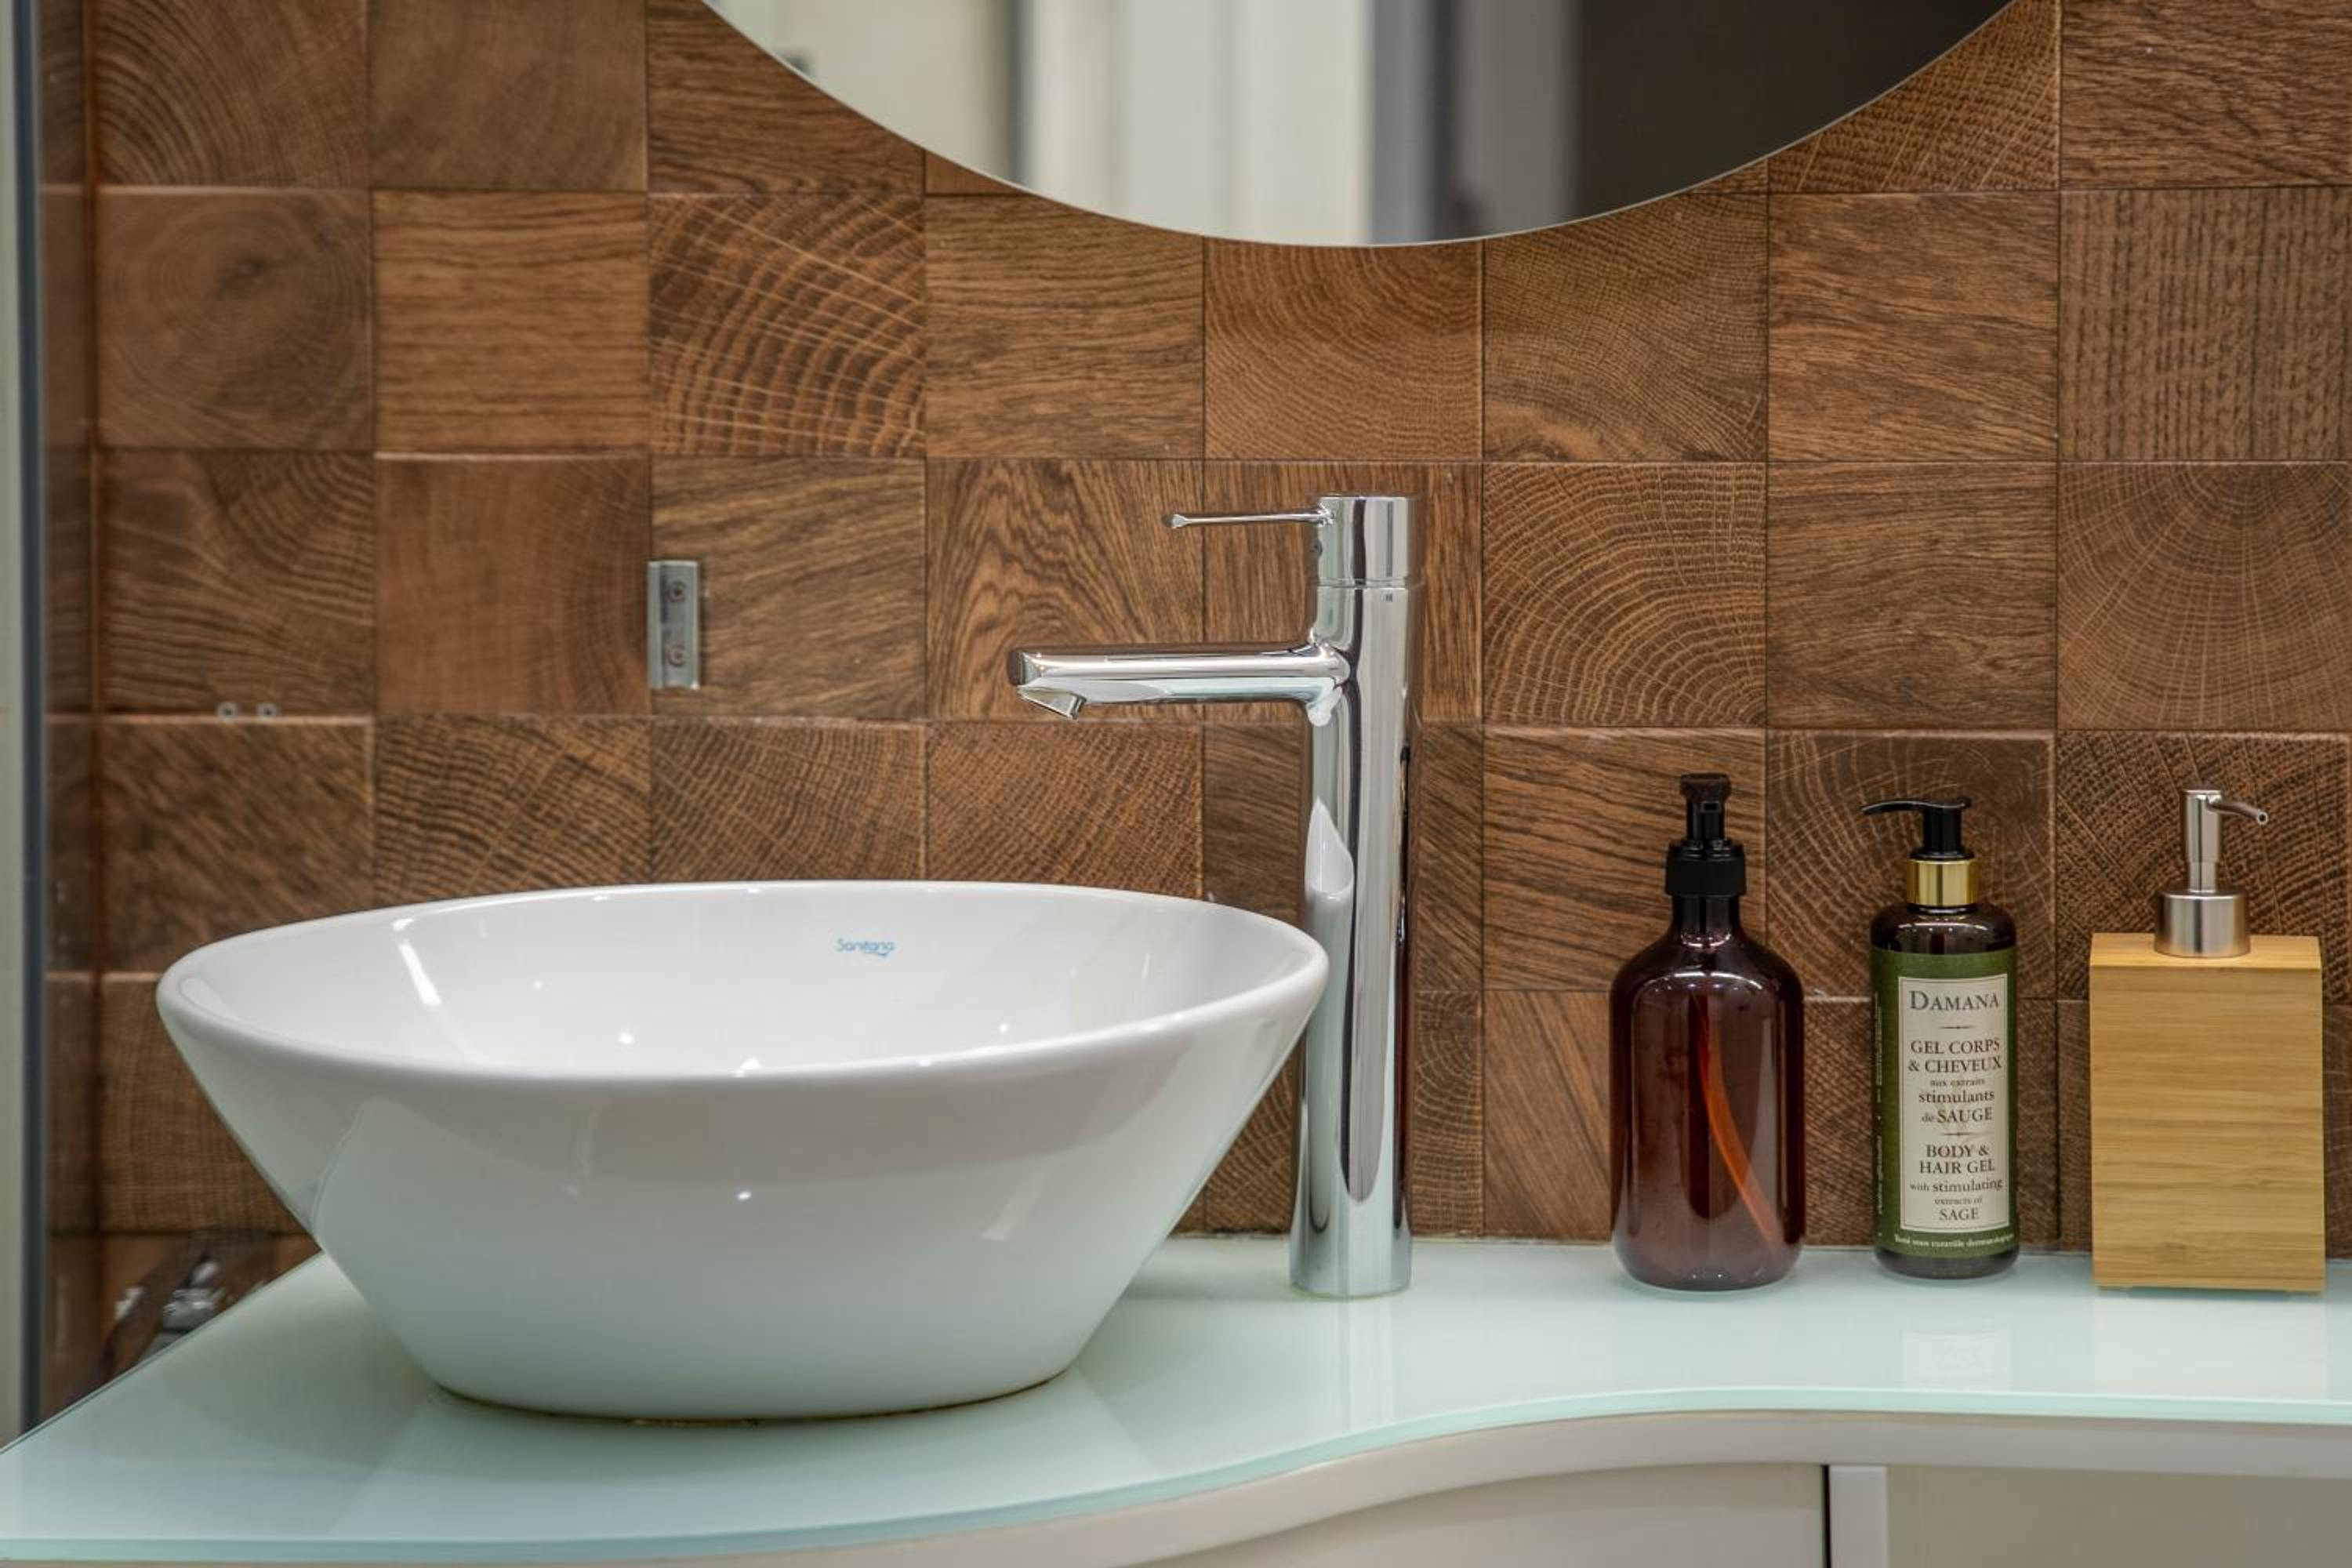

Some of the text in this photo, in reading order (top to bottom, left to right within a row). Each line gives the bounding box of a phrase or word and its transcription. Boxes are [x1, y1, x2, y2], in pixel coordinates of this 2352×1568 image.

[1908, 990, 1999, 1011] DAMANA
[1911, 1038, 2000, 1054] GEL CORPS
[1907, 1056, 2002, 1073] & CHEVEUX
[1919, 1090, 1994, 1104] stimulants
[1922, 1107, 1993, 1123] de SAUGE
[1926, 1145, 1989, 1158] BODY &
[1919, 1159, 1995, 1174] HAIR GEL
[1933, 1177, 2003, 1193] stimulating
[1939, 1208, 1979, 1221] SAGE
